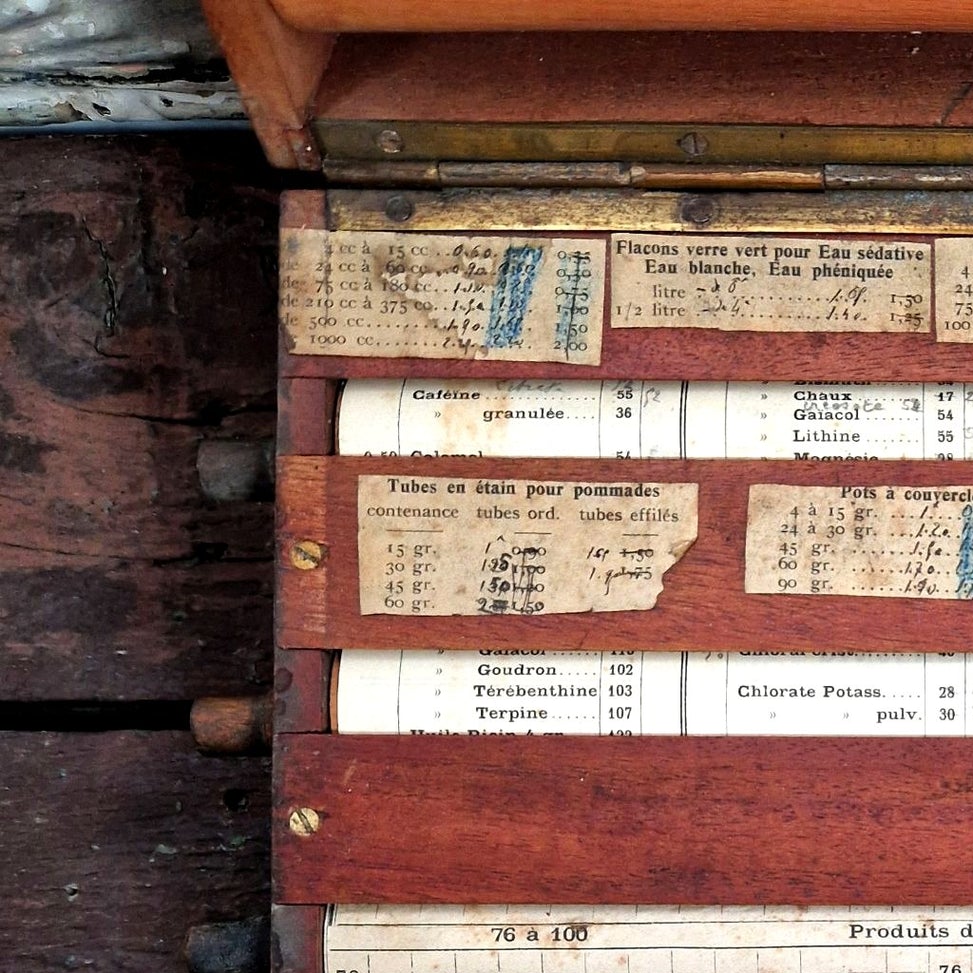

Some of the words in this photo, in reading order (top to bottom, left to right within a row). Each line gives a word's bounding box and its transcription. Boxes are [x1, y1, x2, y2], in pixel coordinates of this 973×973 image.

[616, 241, 678, 256] Flacons
[687, 245, 728, 257] verre
[736, 244, 766, 257] vert
[774, 247, 811, 261] pour
[819, 245, 850, 259] Eau
[858, 244, 924, 261] sédative
[645, 259, 677, 274] Eau
[689, 260, 756, 277] blanche,
[769, 262, 801, 277] Eau
[813, 264, 893, 282] phéniquée
[653, 285, 685, 298] litre
[955, 284, 973, 296] 24
[653, 304, 685, 316] litre
[945, 320, 971, 331] 100
[794, 391, 852, 401] Chaux
[938, 392, 953, 401] 17
[483, 408, 564, 422] granulée
[616, 408, 631, 418] 36
[937, 410, 953, 420] 54
[793, 430, 860, 442] Lithine
[937, 431, 953, 442] 55
[388, 479, 437, 494] Tubes
[447, 484, 466, 494] en
[476, 480, 515, 495] étain
[527, 485, 564, 498] pour
[574, 484, 660, 500] pommades
[841, 487, 876, 499] Pots
[367, 506, 459, 518] contenance
[477, 507, 520, 520] tubes
[529, 507, 560, 520] ord.
[580, 509, 622, 521] tubes
[631, 508, 678, 522] effilés
[387, 545, 404, 556] 15
[414, 545, 436, 557] gr.
[779, 543, 797, 555] 45
[812, 544, 835, 556] gr.
[778, 578, 797, 589] 90
[811, 578, 833, 592] gr.
[384, 597, 403, 609] 60
[412, 599, 435, 613] gr.
[478, 664, 557, 676] Goudron
[609, 665, 633, 675] 102
[474, 685, 597, 697] Térébenthine
[608, 686, 632, 697] 103
[738, 685, 815, 698] Chlorate
[939, 687, 955, 698] 28
[476, 707, 548, 722] Terpine
[608, 708, 632, 719] 107
[877, 708, 921, 723] pulv.
[939, 709, 955, 721] 30
[491, 928, 515, 941] 76
[527, 928, 539, 941] à
[552, 927, 588, 941] 100
[849, 923, 949, 938] Produits
